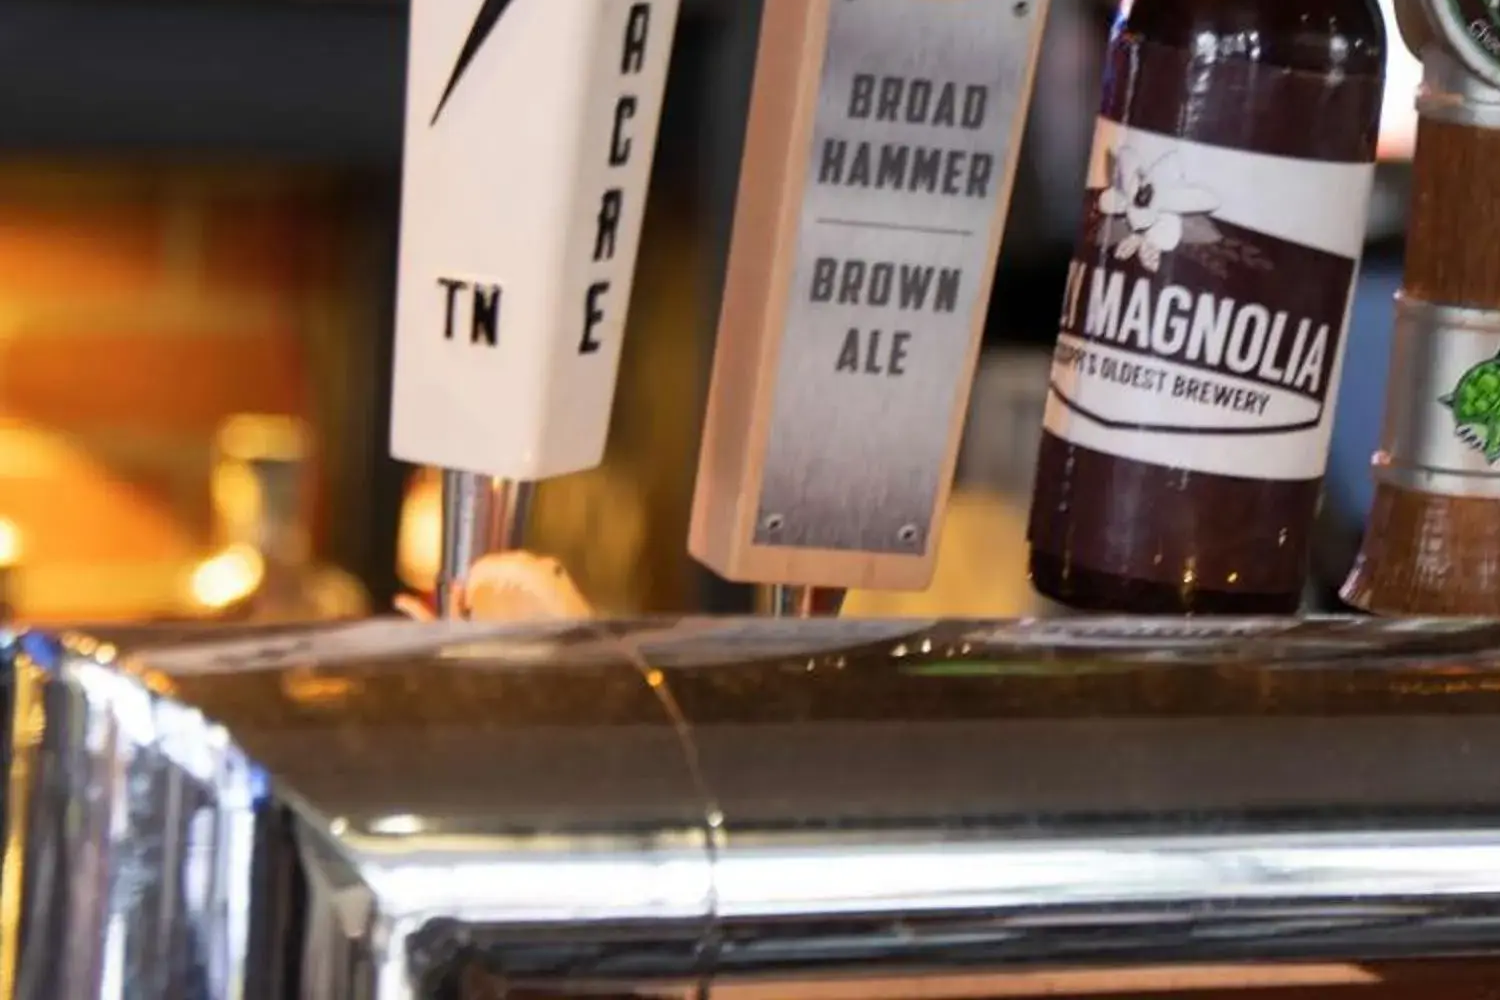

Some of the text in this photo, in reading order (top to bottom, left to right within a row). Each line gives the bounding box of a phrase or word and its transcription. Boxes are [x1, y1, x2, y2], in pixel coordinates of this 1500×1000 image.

[847, 73, 989, 131] BROAD
[817, 138, 995, 199] HAMMER
[437, 277, 502, 348] TN
[808, 256, 963, 314] BROWN
[834, 327, 912, 377] ALE
[1085, 266, 1330, 394] MAGNOLIA
[1099, 356, 1168, 393] OLDEST
[1170, 373, 1271, 416] BREWERY
